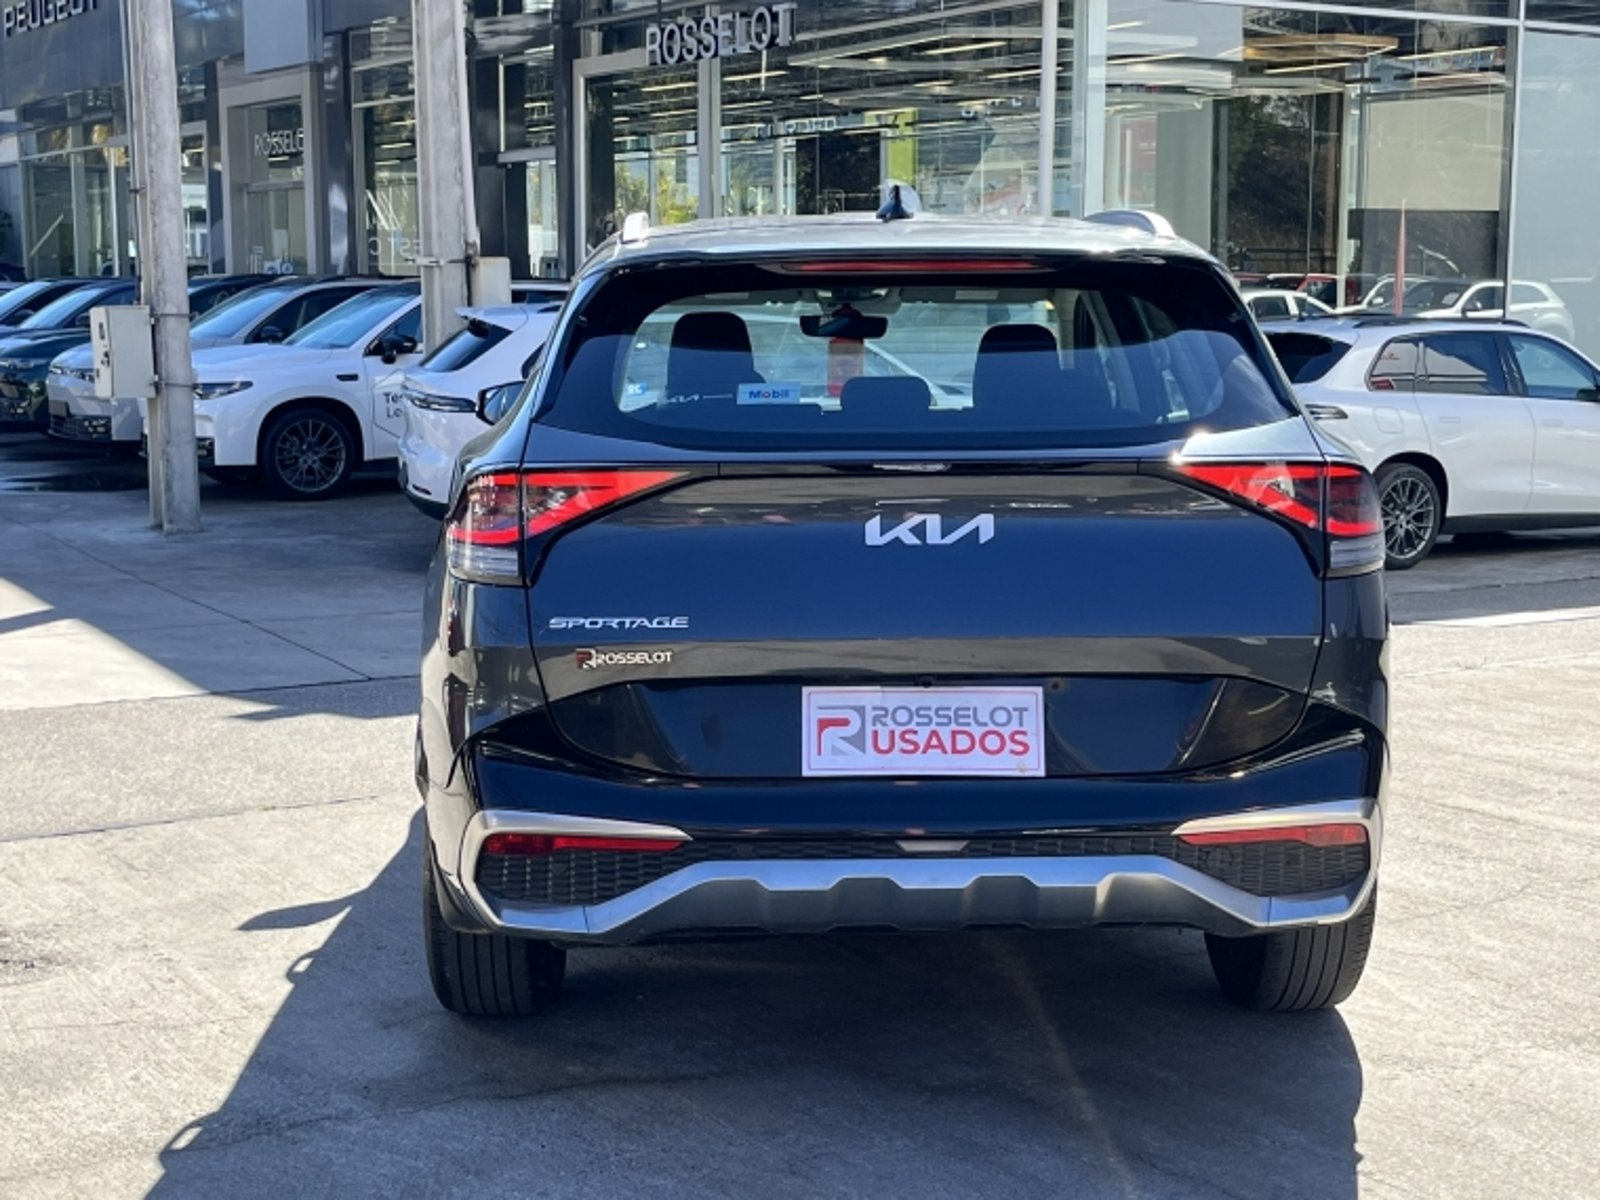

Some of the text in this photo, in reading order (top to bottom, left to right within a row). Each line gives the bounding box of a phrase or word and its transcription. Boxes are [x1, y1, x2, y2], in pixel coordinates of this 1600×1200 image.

[646, 3, 797, 65] ROSSELOT
[749, 389, 790, 399] Mobil
[865, 513, 995, 546] KIA
[549, 616, 689, 629] SPORTAGE
[596, 651, 672, 665] ROSSELOT
[871, 706, 1029, 727] ROSSELOT
[871, 729, 1031, 756] USADOS
